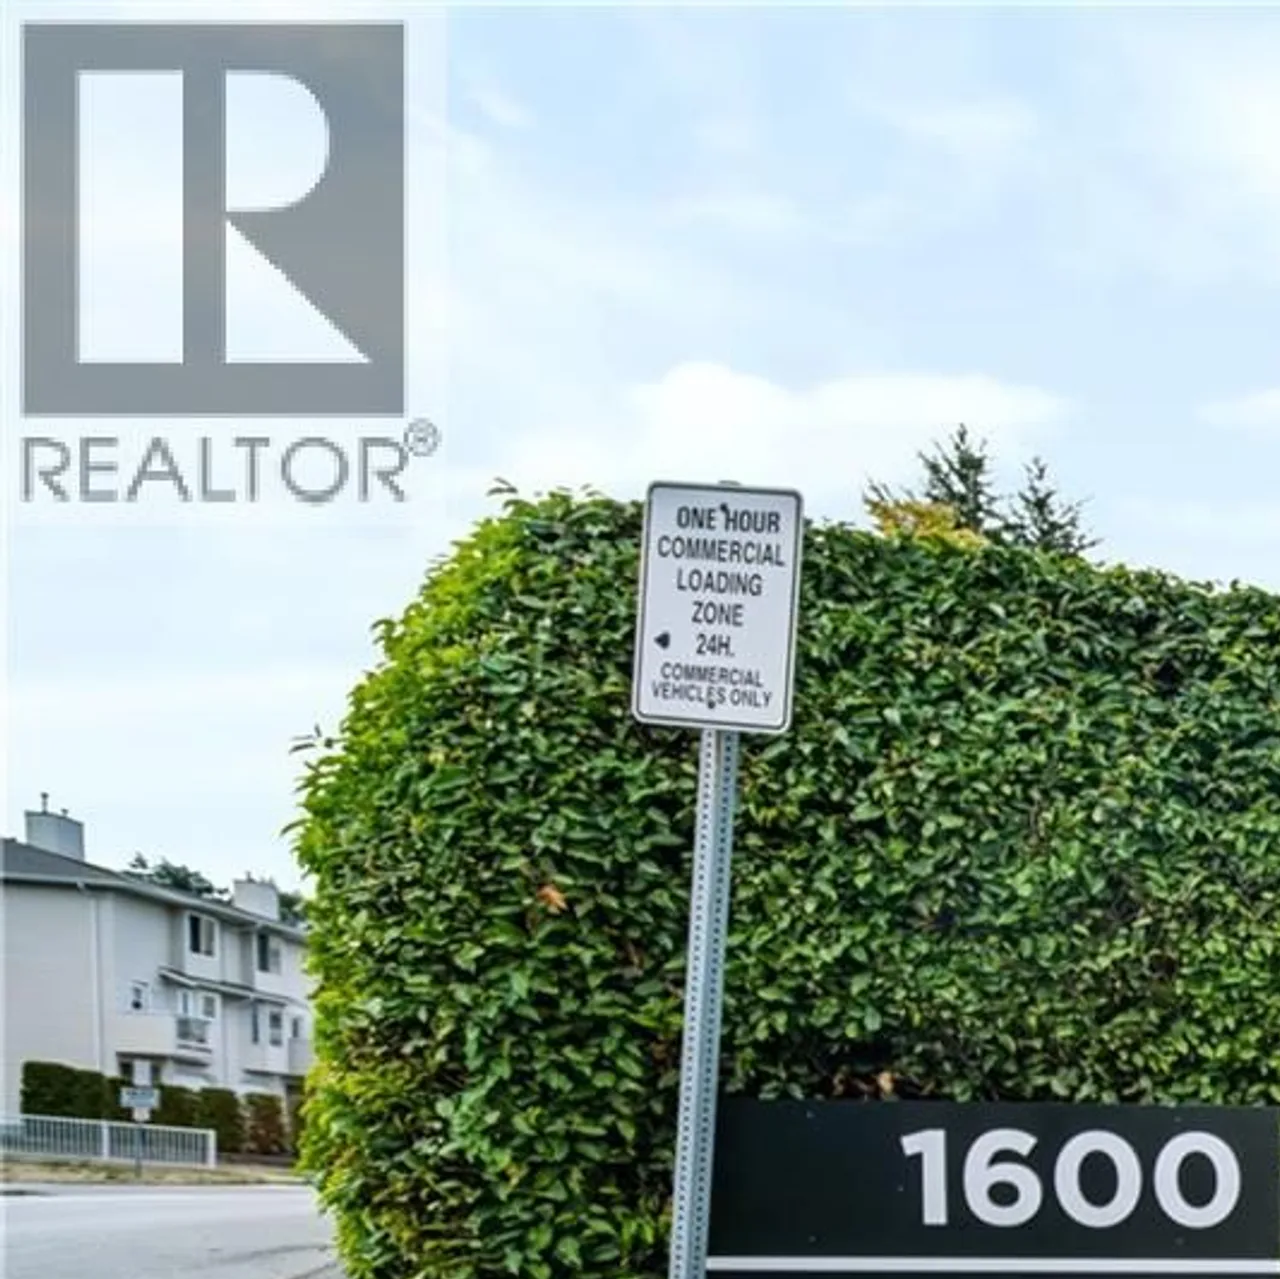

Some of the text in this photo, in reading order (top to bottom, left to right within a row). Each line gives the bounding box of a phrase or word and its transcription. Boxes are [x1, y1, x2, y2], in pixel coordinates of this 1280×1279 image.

[677, 506, 780, 532] ONE HOUR
[657, 536, 786, 566] COMMERCIAL
[677, 569, 762, 596] LOADING
[691, 601, 744, 626] ZONE
[660, 662, 763, 687] COMMERCIAL
[651, 682, 773, 708] VEHICLES ONLY
[901, 1128, 1241, 1228] 1600
